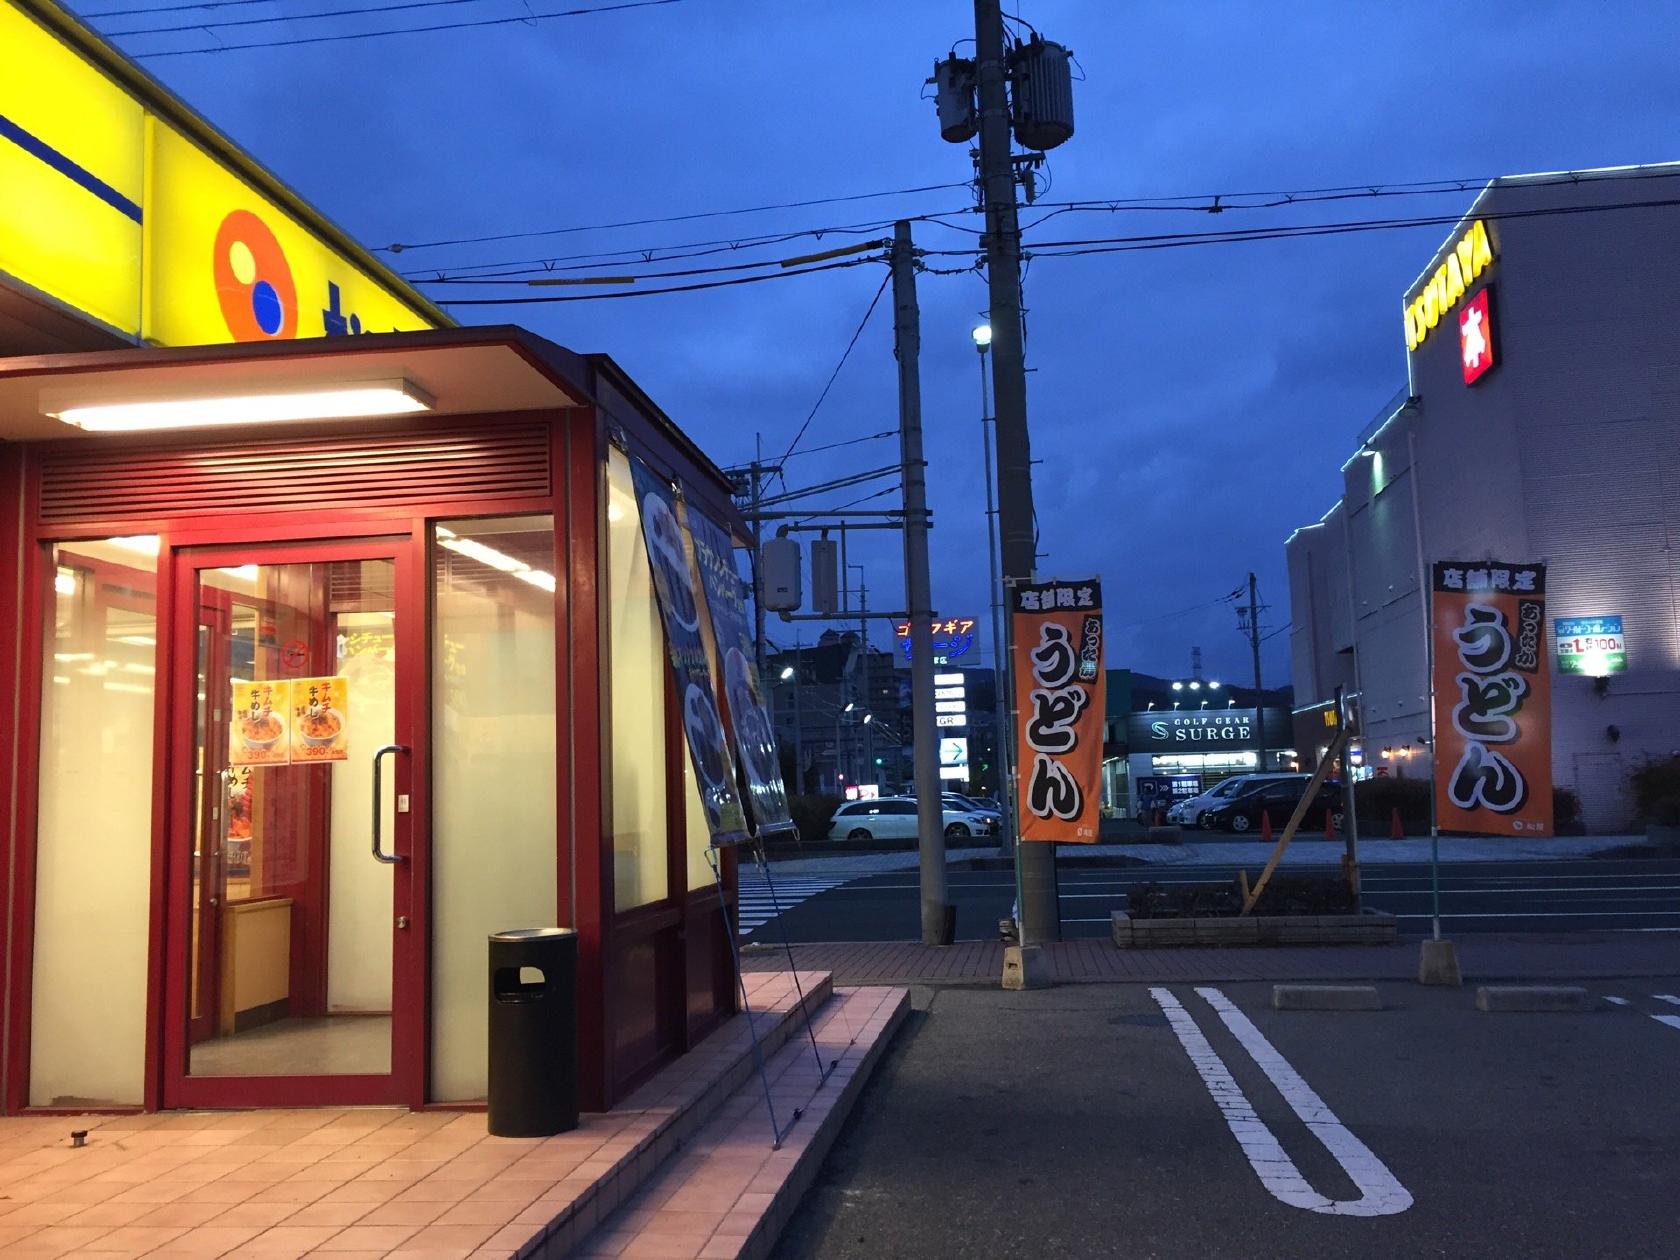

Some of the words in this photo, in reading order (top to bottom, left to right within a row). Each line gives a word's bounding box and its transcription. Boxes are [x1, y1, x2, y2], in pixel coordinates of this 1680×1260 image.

[1443, 568, 1537, 591] 店舗限定
[1020, 586, 1094, 610] 店舗限定
[897, 619, 974, 636] ゴフギア
[1515, 602, 1540, 667] あったか
[263, 686, 273, 716] キムチ
[321, 682, 332, 713] キムチ
[1448, 602, 1527, 813] うどん
[1026, 621, 1088, 822] うどん
[1174, 717, 1209, 726] GOLF
[1215, 716, 1250, 725] GEAR
[1175, 726, 1251, 741] SURGE
